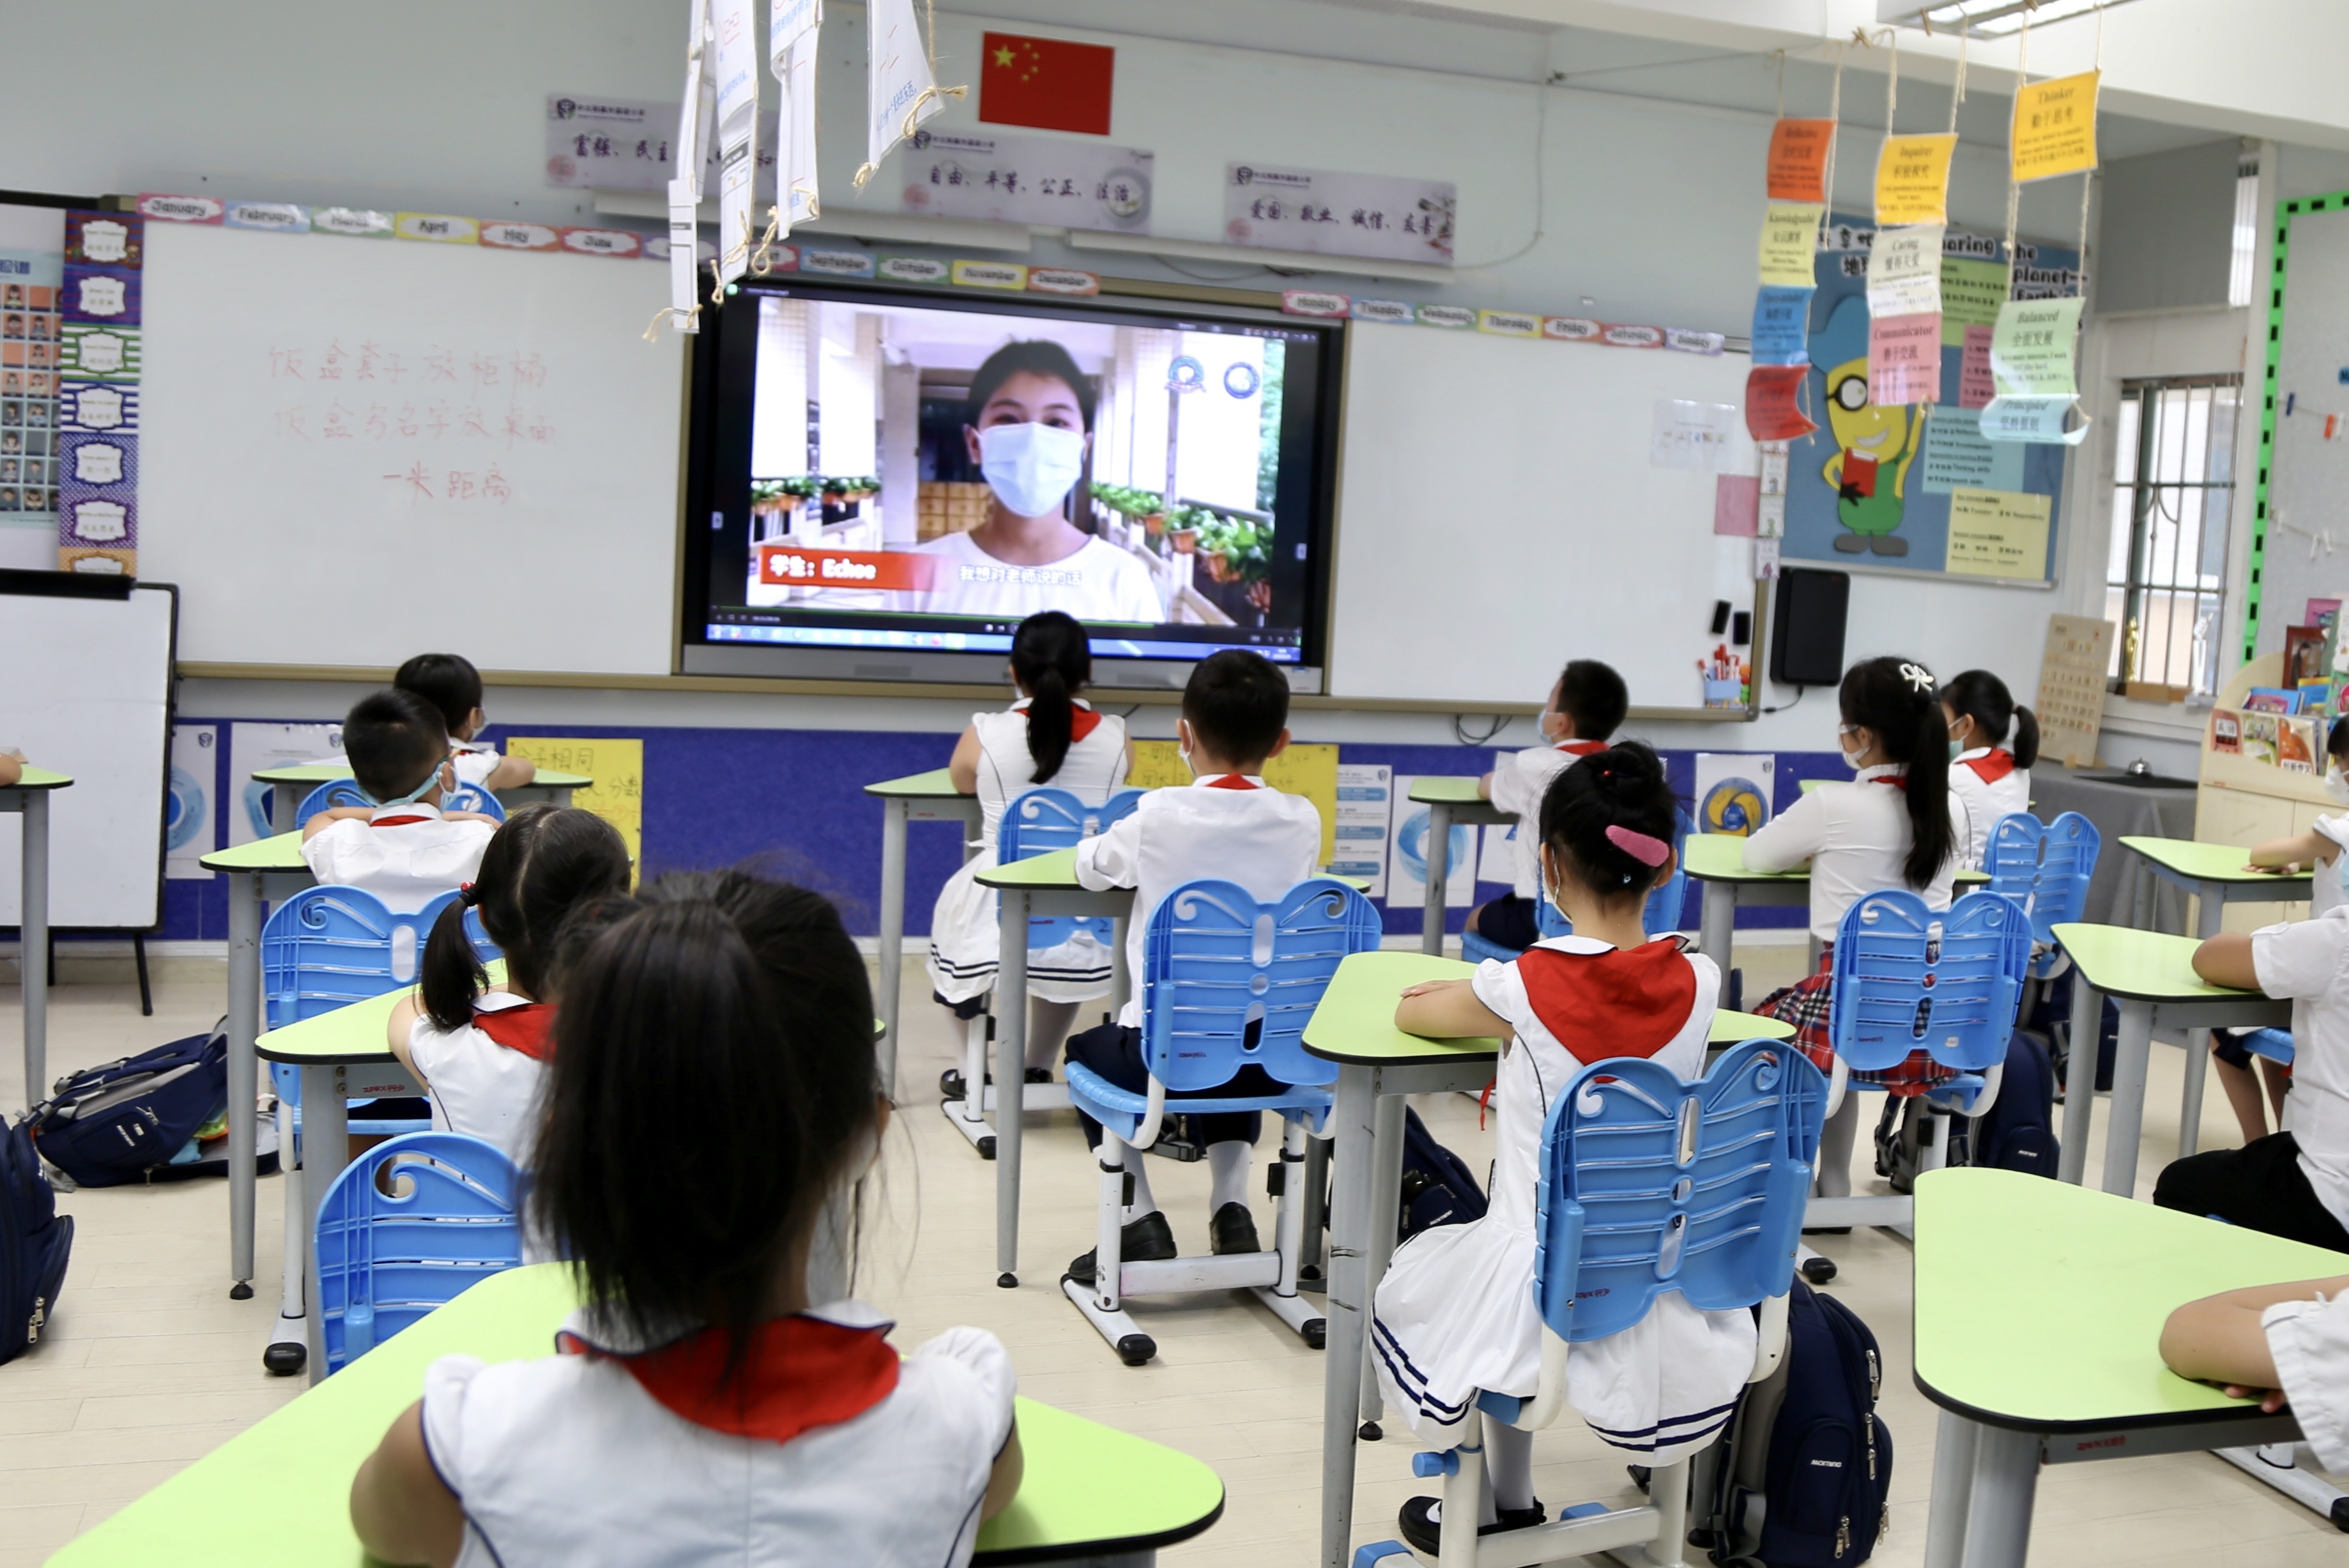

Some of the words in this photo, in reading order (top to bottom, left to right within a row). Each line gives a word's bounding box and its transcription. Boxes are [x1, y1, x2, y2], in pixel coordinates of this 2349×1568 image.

[2038, 88, 2075, 105] Thinker
[1900, 144, 1934, 159] Inquirer
[931, 164, 1129, 201] 自由、平等、公正、法治
[151, 198, 207, 216] January
[238, 206, 298, 225] February
[1251, 198, 1434, 235] 爱国、敬业、诚信、友善
[418, 218, 450, 234] April
[503, 228, 530, 243] May
[584, 236, 613, 248] June
[1892, 237, 1919, 250] Caring
[809, 255, 867, 271] September
[892, 257, 937, 275] October
[964, 265, 1017, 281] November
[1037, 271, 1088, 287] December
[1297, 296, 1337, 310] Monday
[1360, 300, 1405, 317] Tuesday
[1423, 308, 1473, 323] Wednesday
[1488, 314, 1533, 331] Thursday
[2017, 308, 2060, 323] Balanced
[1556, 321, 1589, 335] Friday
[1611, 327, 1653, 343] Saturday
[1874, 326, 1933, 339] Communicator
[1677, 333, 1711, 349] Sunday
[382, 460, 512, 505] 一米距离
[822, 558, 876, 581] Echoe
[959, 564, 1083, 586] 我想对老师说的话
